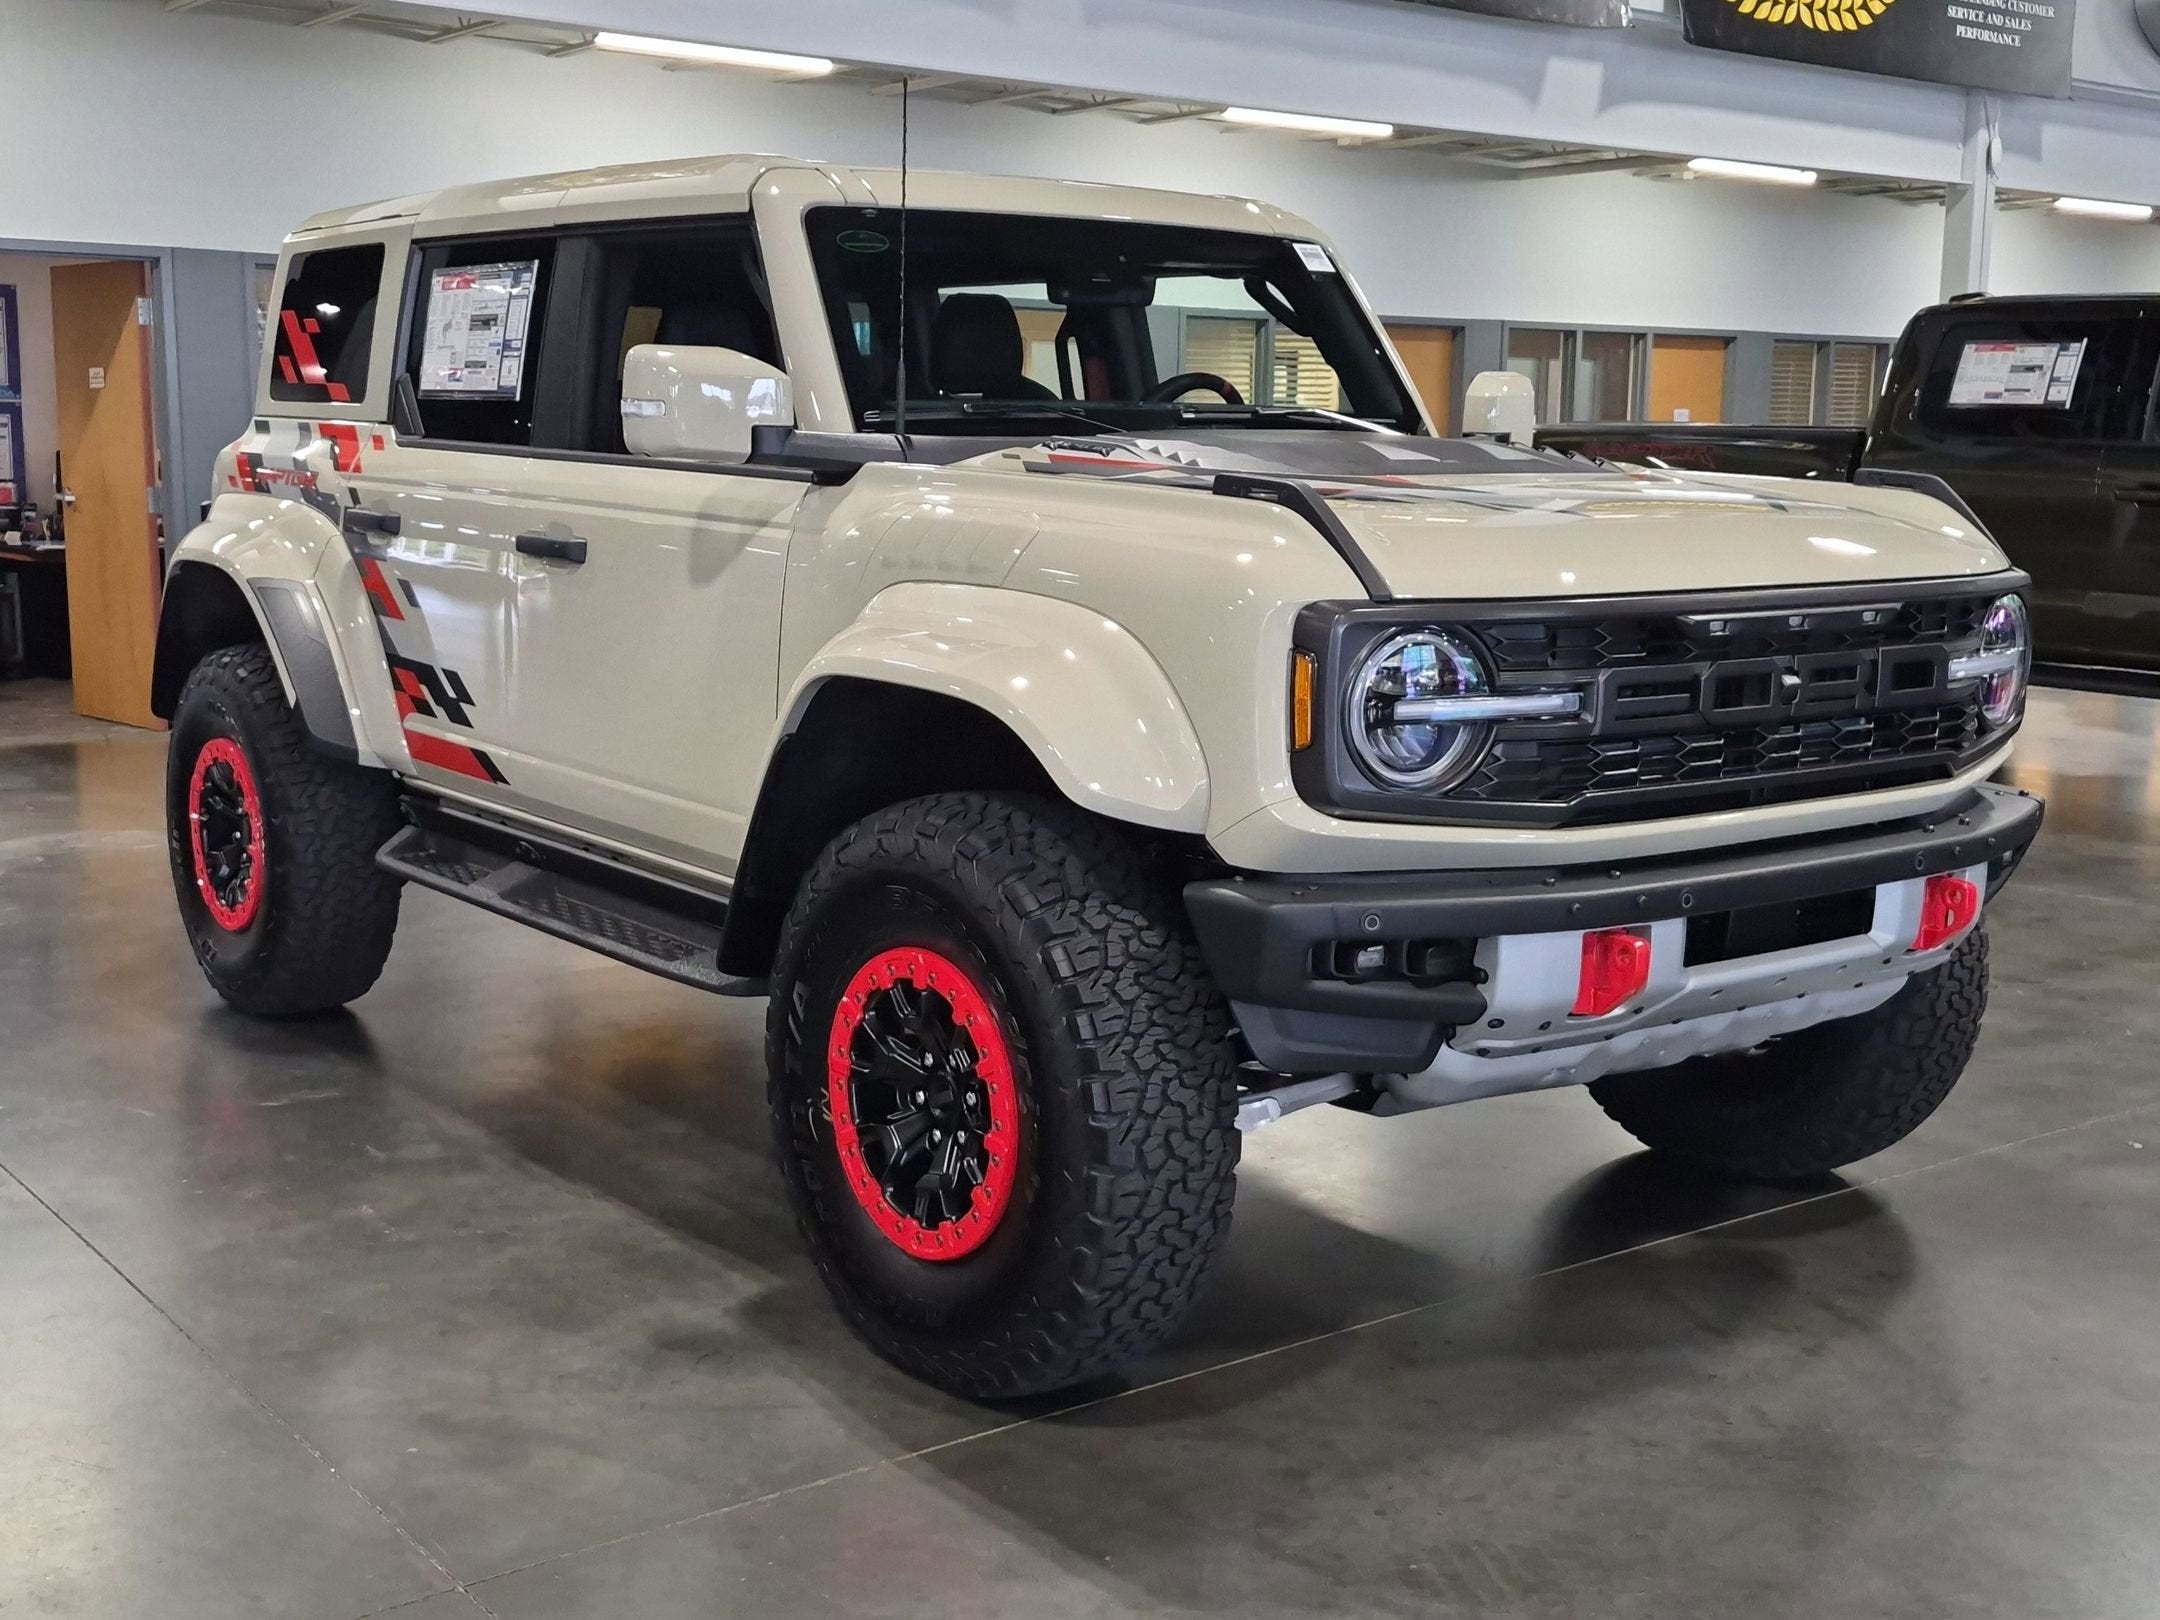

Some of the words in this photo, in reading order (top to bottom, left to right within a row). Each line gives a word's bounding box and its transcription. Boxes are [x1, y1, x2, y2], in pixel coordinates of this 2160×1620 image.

[1947, 5, 1985, 22] SERVICE
[1986, 13, 2004, 26] AND
[2004, 16, 2032, 31] SALES
[2007, 0, 2055, 17] CUSTOMER
[1956, 24, 2021, 46] PERFORMANCE
